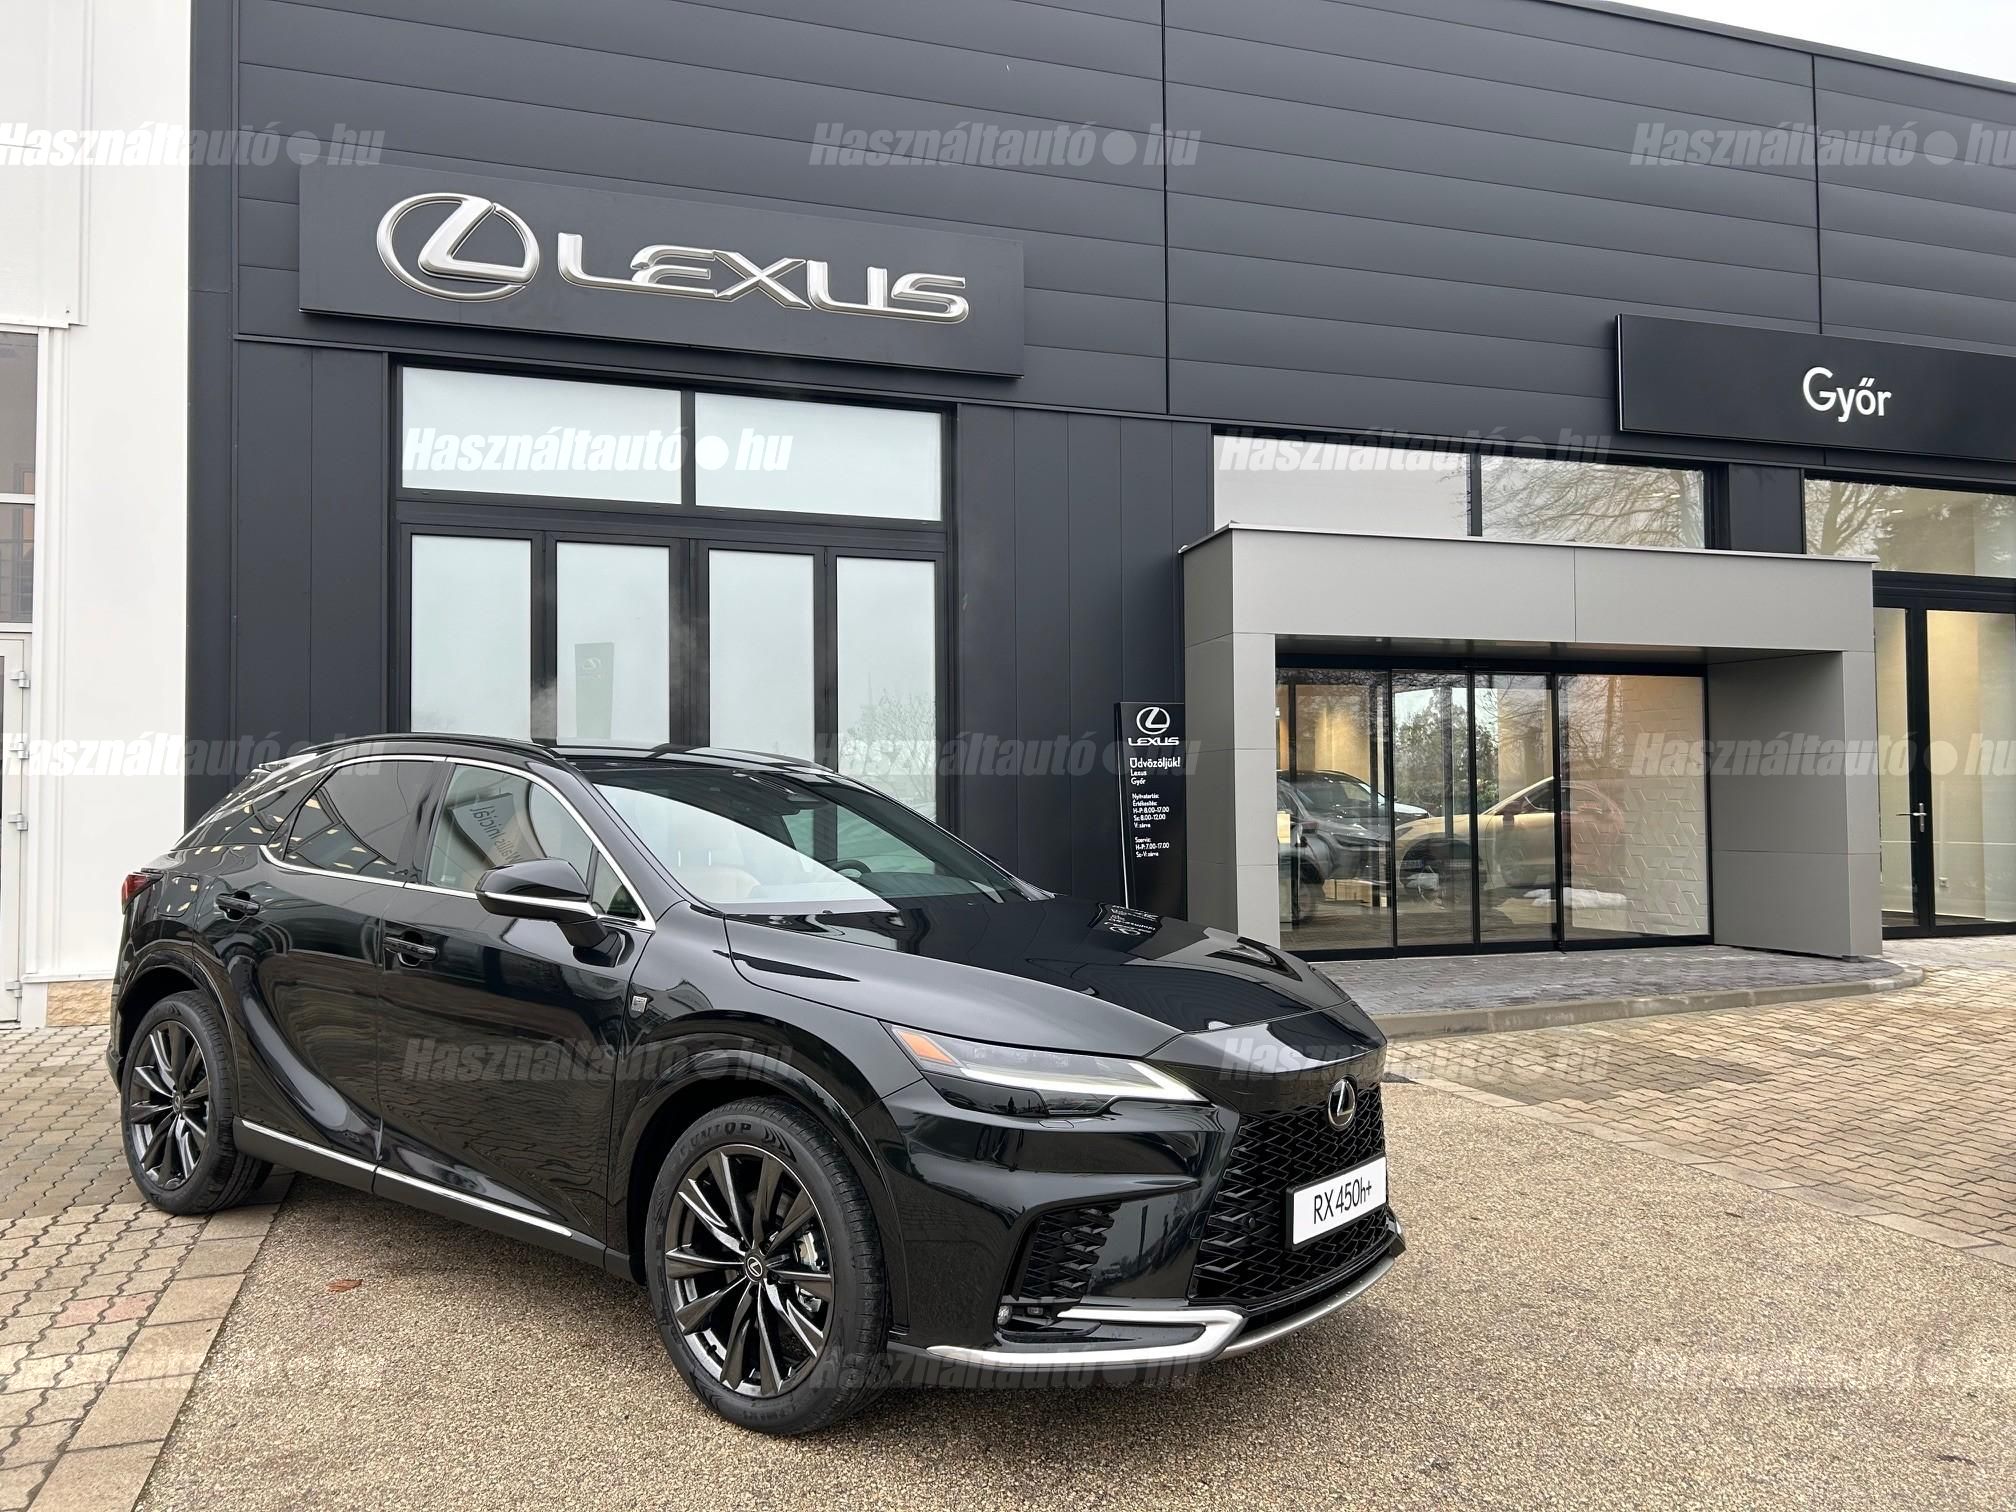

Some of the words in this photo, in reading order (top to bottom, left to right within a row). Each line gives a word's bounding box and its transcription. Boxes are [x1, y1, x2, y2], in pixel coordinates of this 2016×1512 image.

[557, 231, 970, 324] LEXUS
[1801, 365, 1892, 422] Győr
[1128, 736, 1180, 746] LEXUS
[1130, 777, 1146, 786] Győr
[1313, 1188, 1334, 1225] RX
[1335, 1176, 1372, 1213] 450h+
